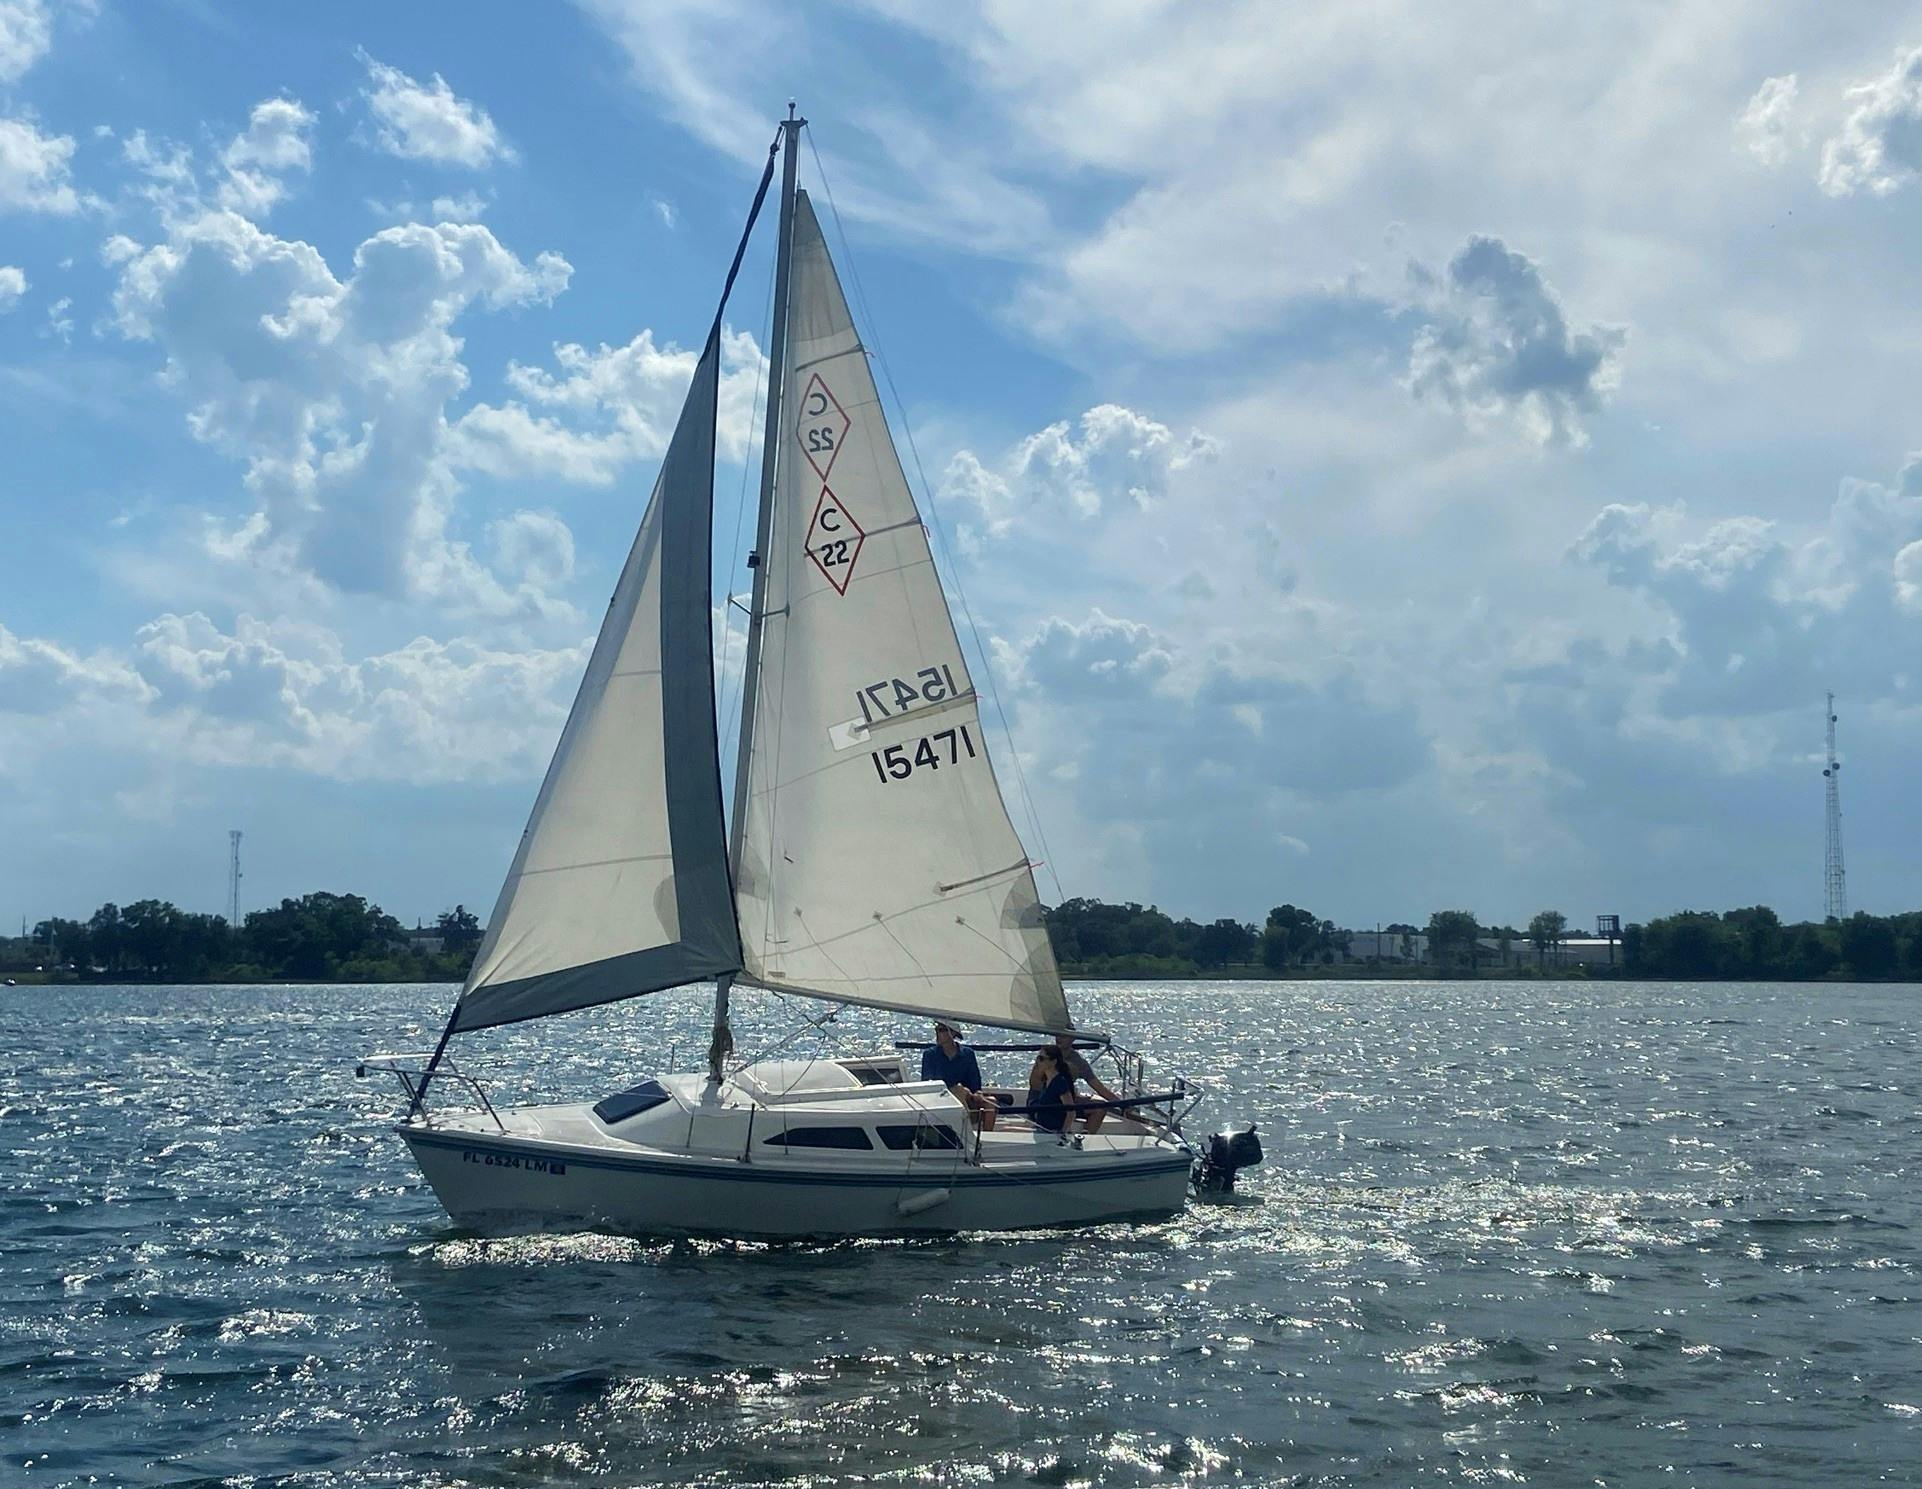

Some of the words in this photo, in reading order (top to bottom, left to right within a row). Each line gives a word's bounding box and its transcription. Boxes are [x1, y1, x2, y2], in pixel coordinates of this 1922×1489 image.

[820, 507, 841, 532] C
[821, 540, 849, 567] 22
[871, 725, 976, 783] 15471
[463, 1151, 480, 1163] FL
[485, 1155, 520, 1168] 6524
[525, 1160, 547, 1172] LM
